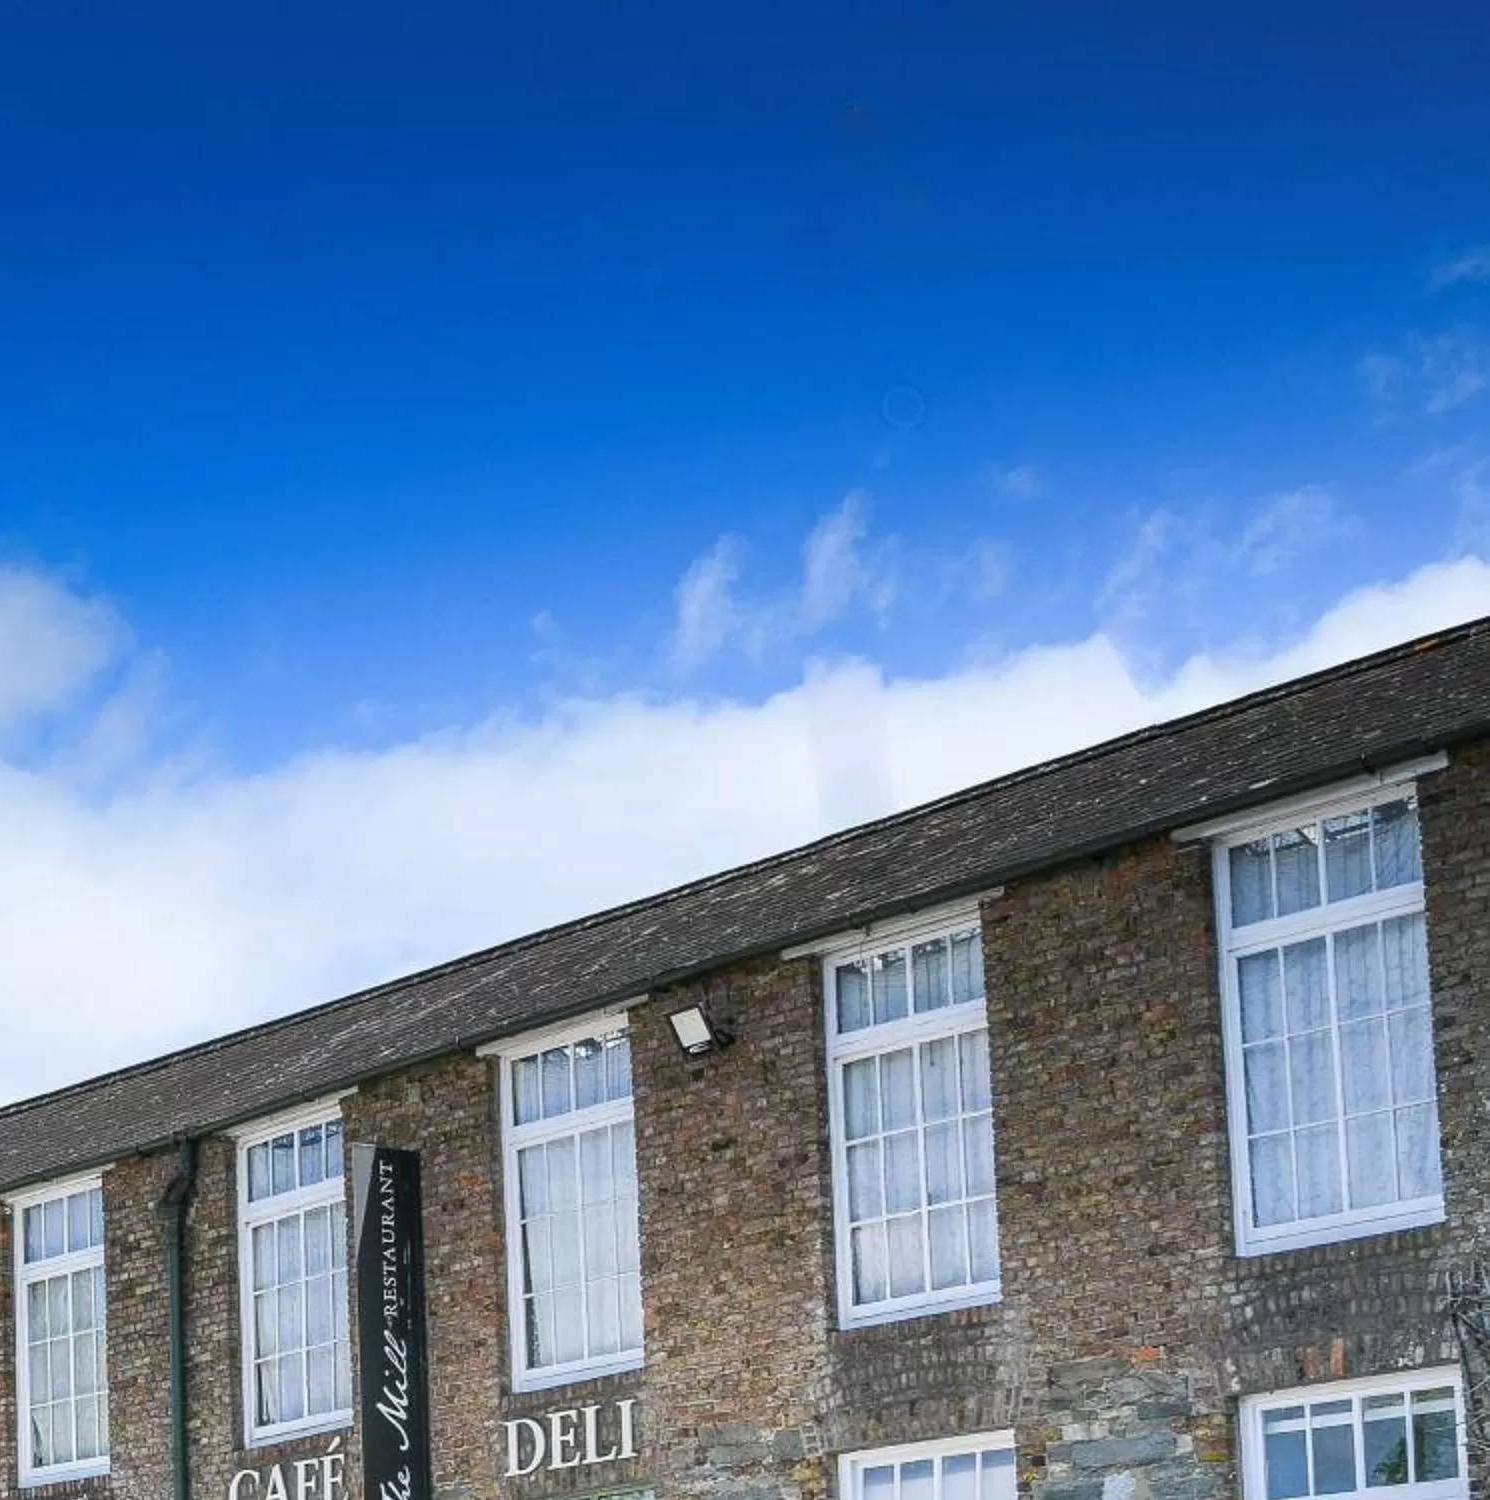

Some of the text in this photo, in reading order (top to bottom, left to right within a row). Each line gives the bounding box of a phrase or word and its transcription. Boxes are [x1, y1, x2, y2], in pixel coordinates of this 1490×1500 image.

[379, 1160, 396, 1317] RESTAURANT
[375, 1329, 410, 1452] Mill
[504, 1400, 638, 1478] DELI
